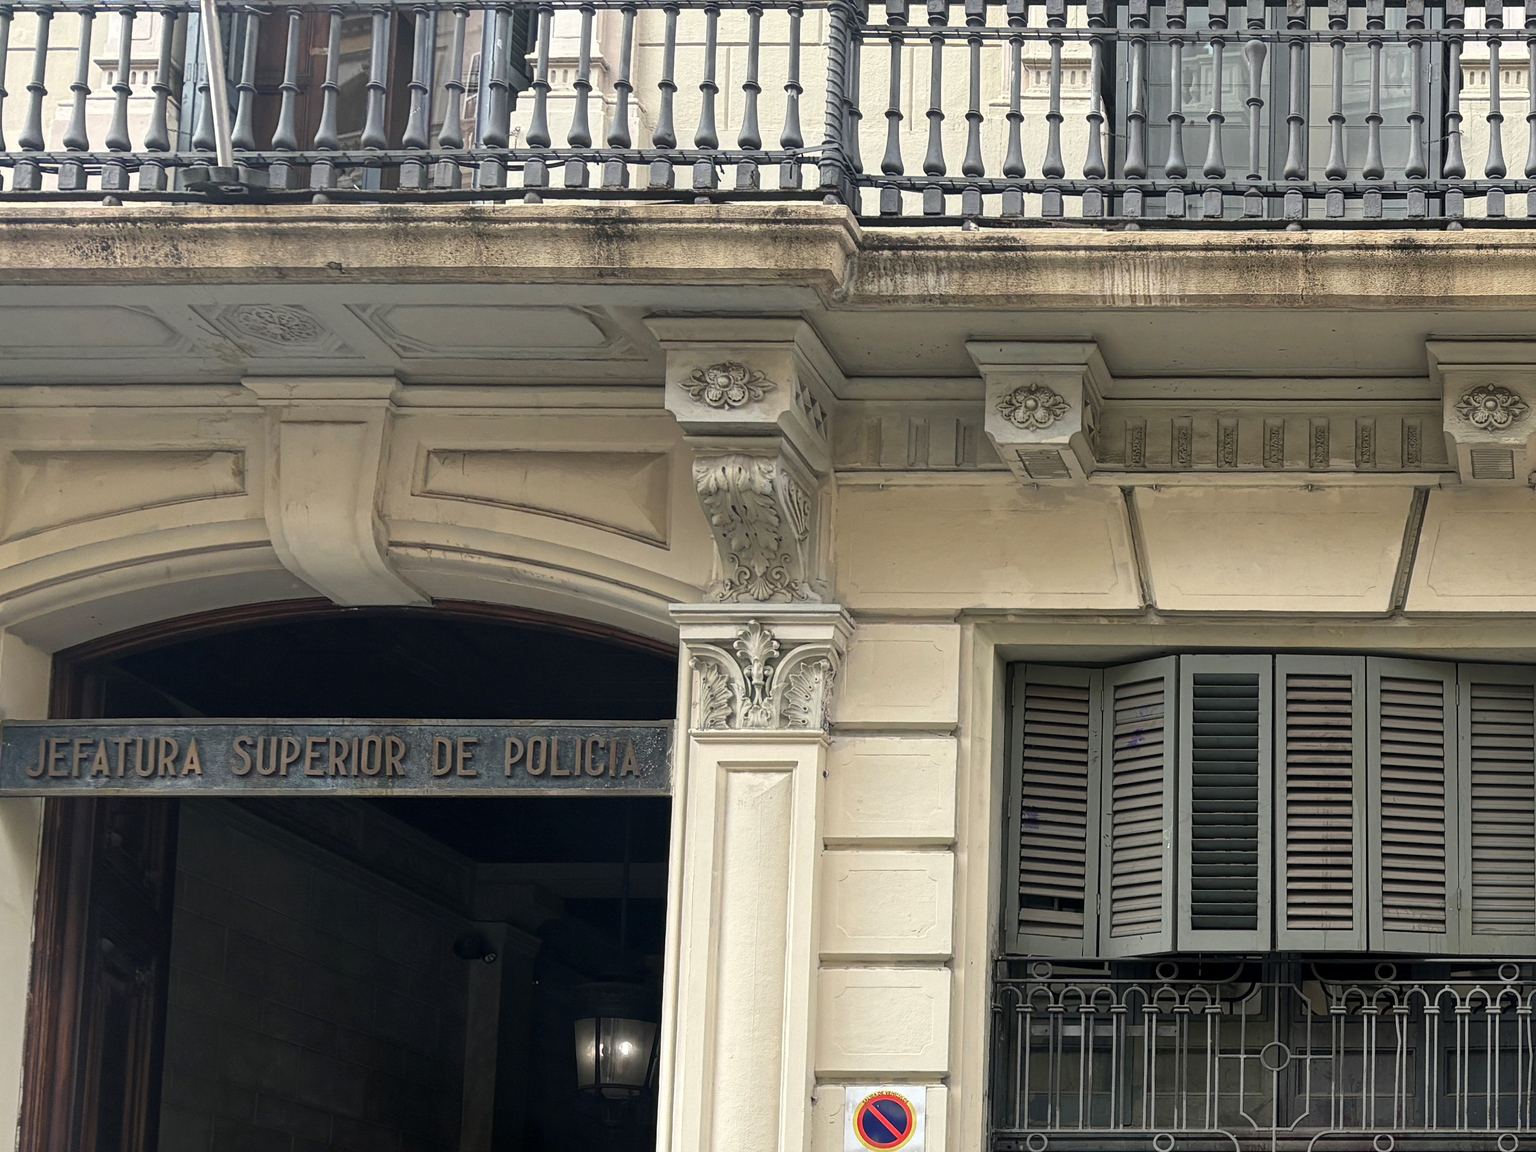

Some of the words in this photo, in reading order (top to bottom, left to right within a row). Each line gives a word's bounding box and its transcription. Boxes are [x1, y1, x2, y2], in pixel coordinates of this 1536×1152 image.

[24, 736, 203, 779] JEFATURA
[230, 734, 406, 778] SUPERIOR
[431, 735, 479, 778] DE
[504, 735, 641, 778] POLICIA
